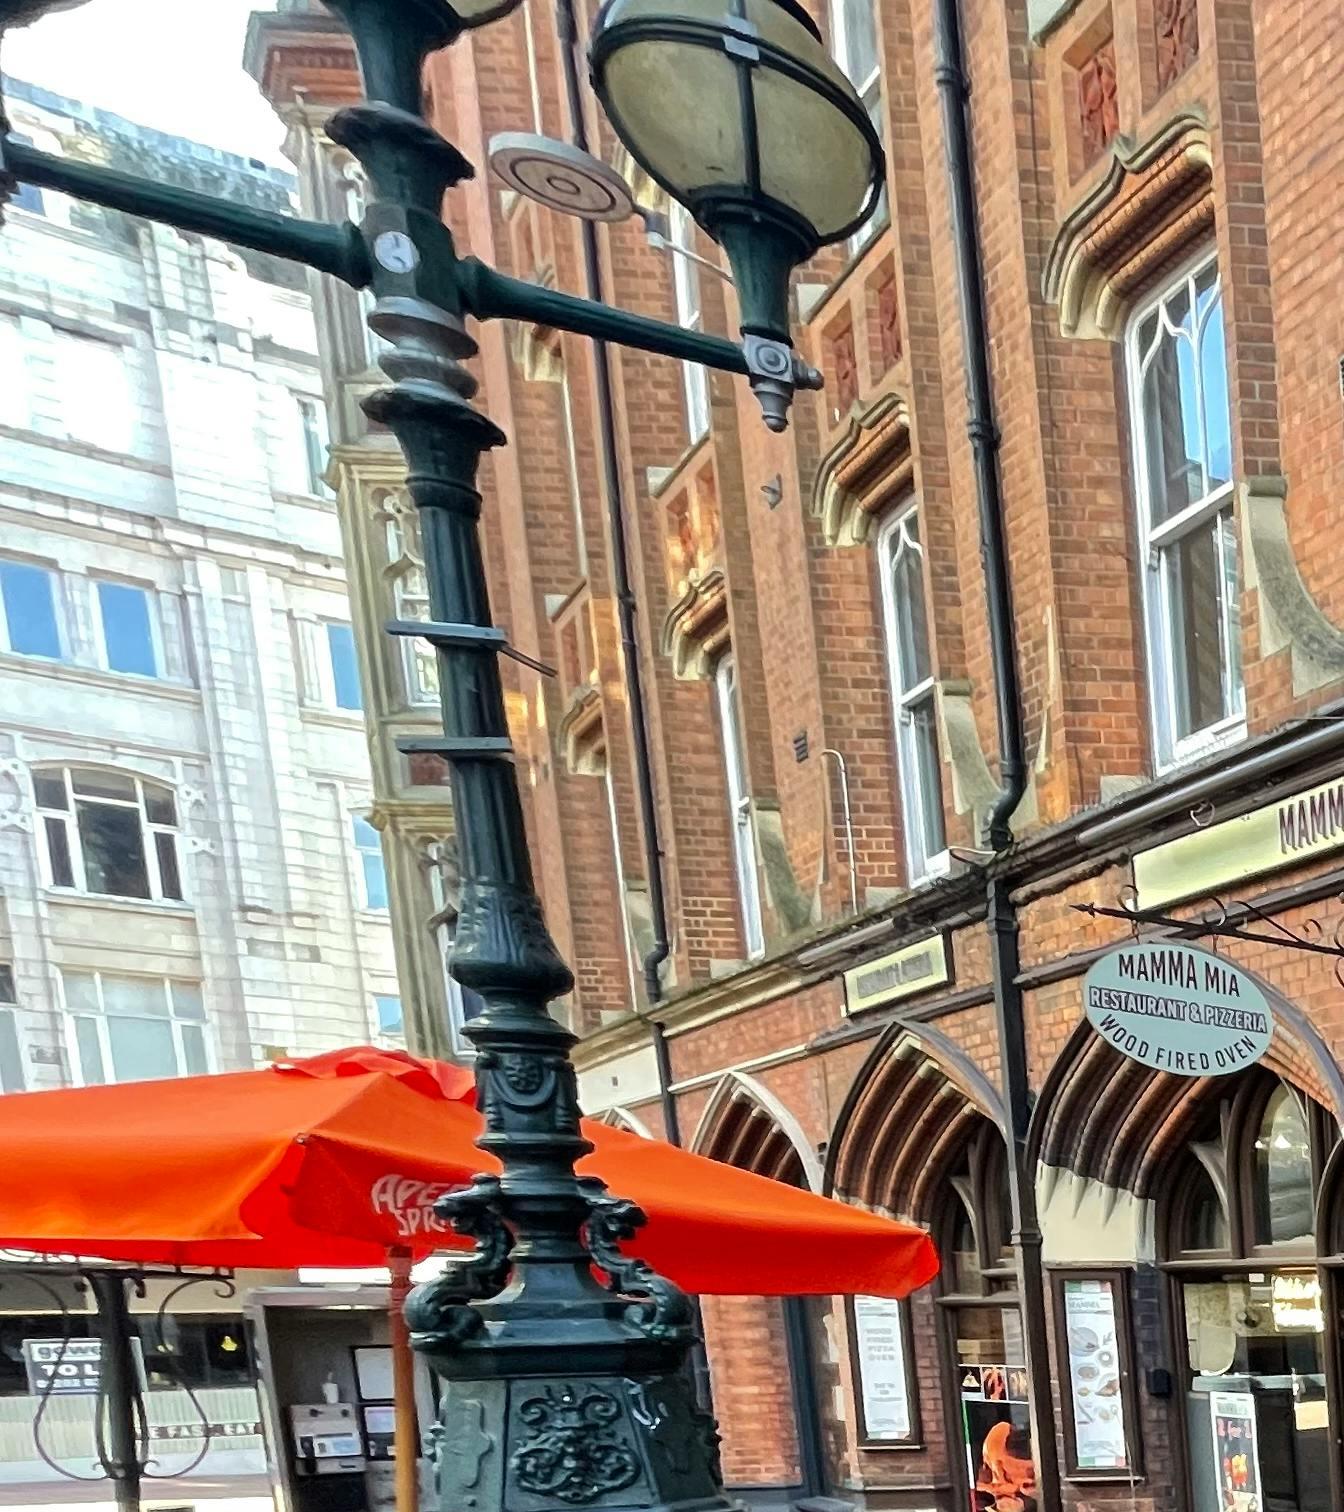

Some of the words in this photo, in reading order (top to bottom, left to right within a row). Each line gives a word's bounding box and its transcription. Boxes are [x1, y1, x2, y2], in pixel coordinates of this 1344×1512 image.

[1118, 950, 1198, 990] MAMMA
[1205, 961, 1240, 997] MIA
[1088, 986, 1187, 1022] RESTAURANT
[1188, 1001, 1201, 1024] &
[1202, 1004, 1268, 1034] PIZZERIA
[1099, 1013, 1149, 1058] WOOD
[1155, 1047, 1211, 1071] FIRED
[1215, 1034, 1257, 1068] OVEN
[393, 1206, 450, 1237] SPR
